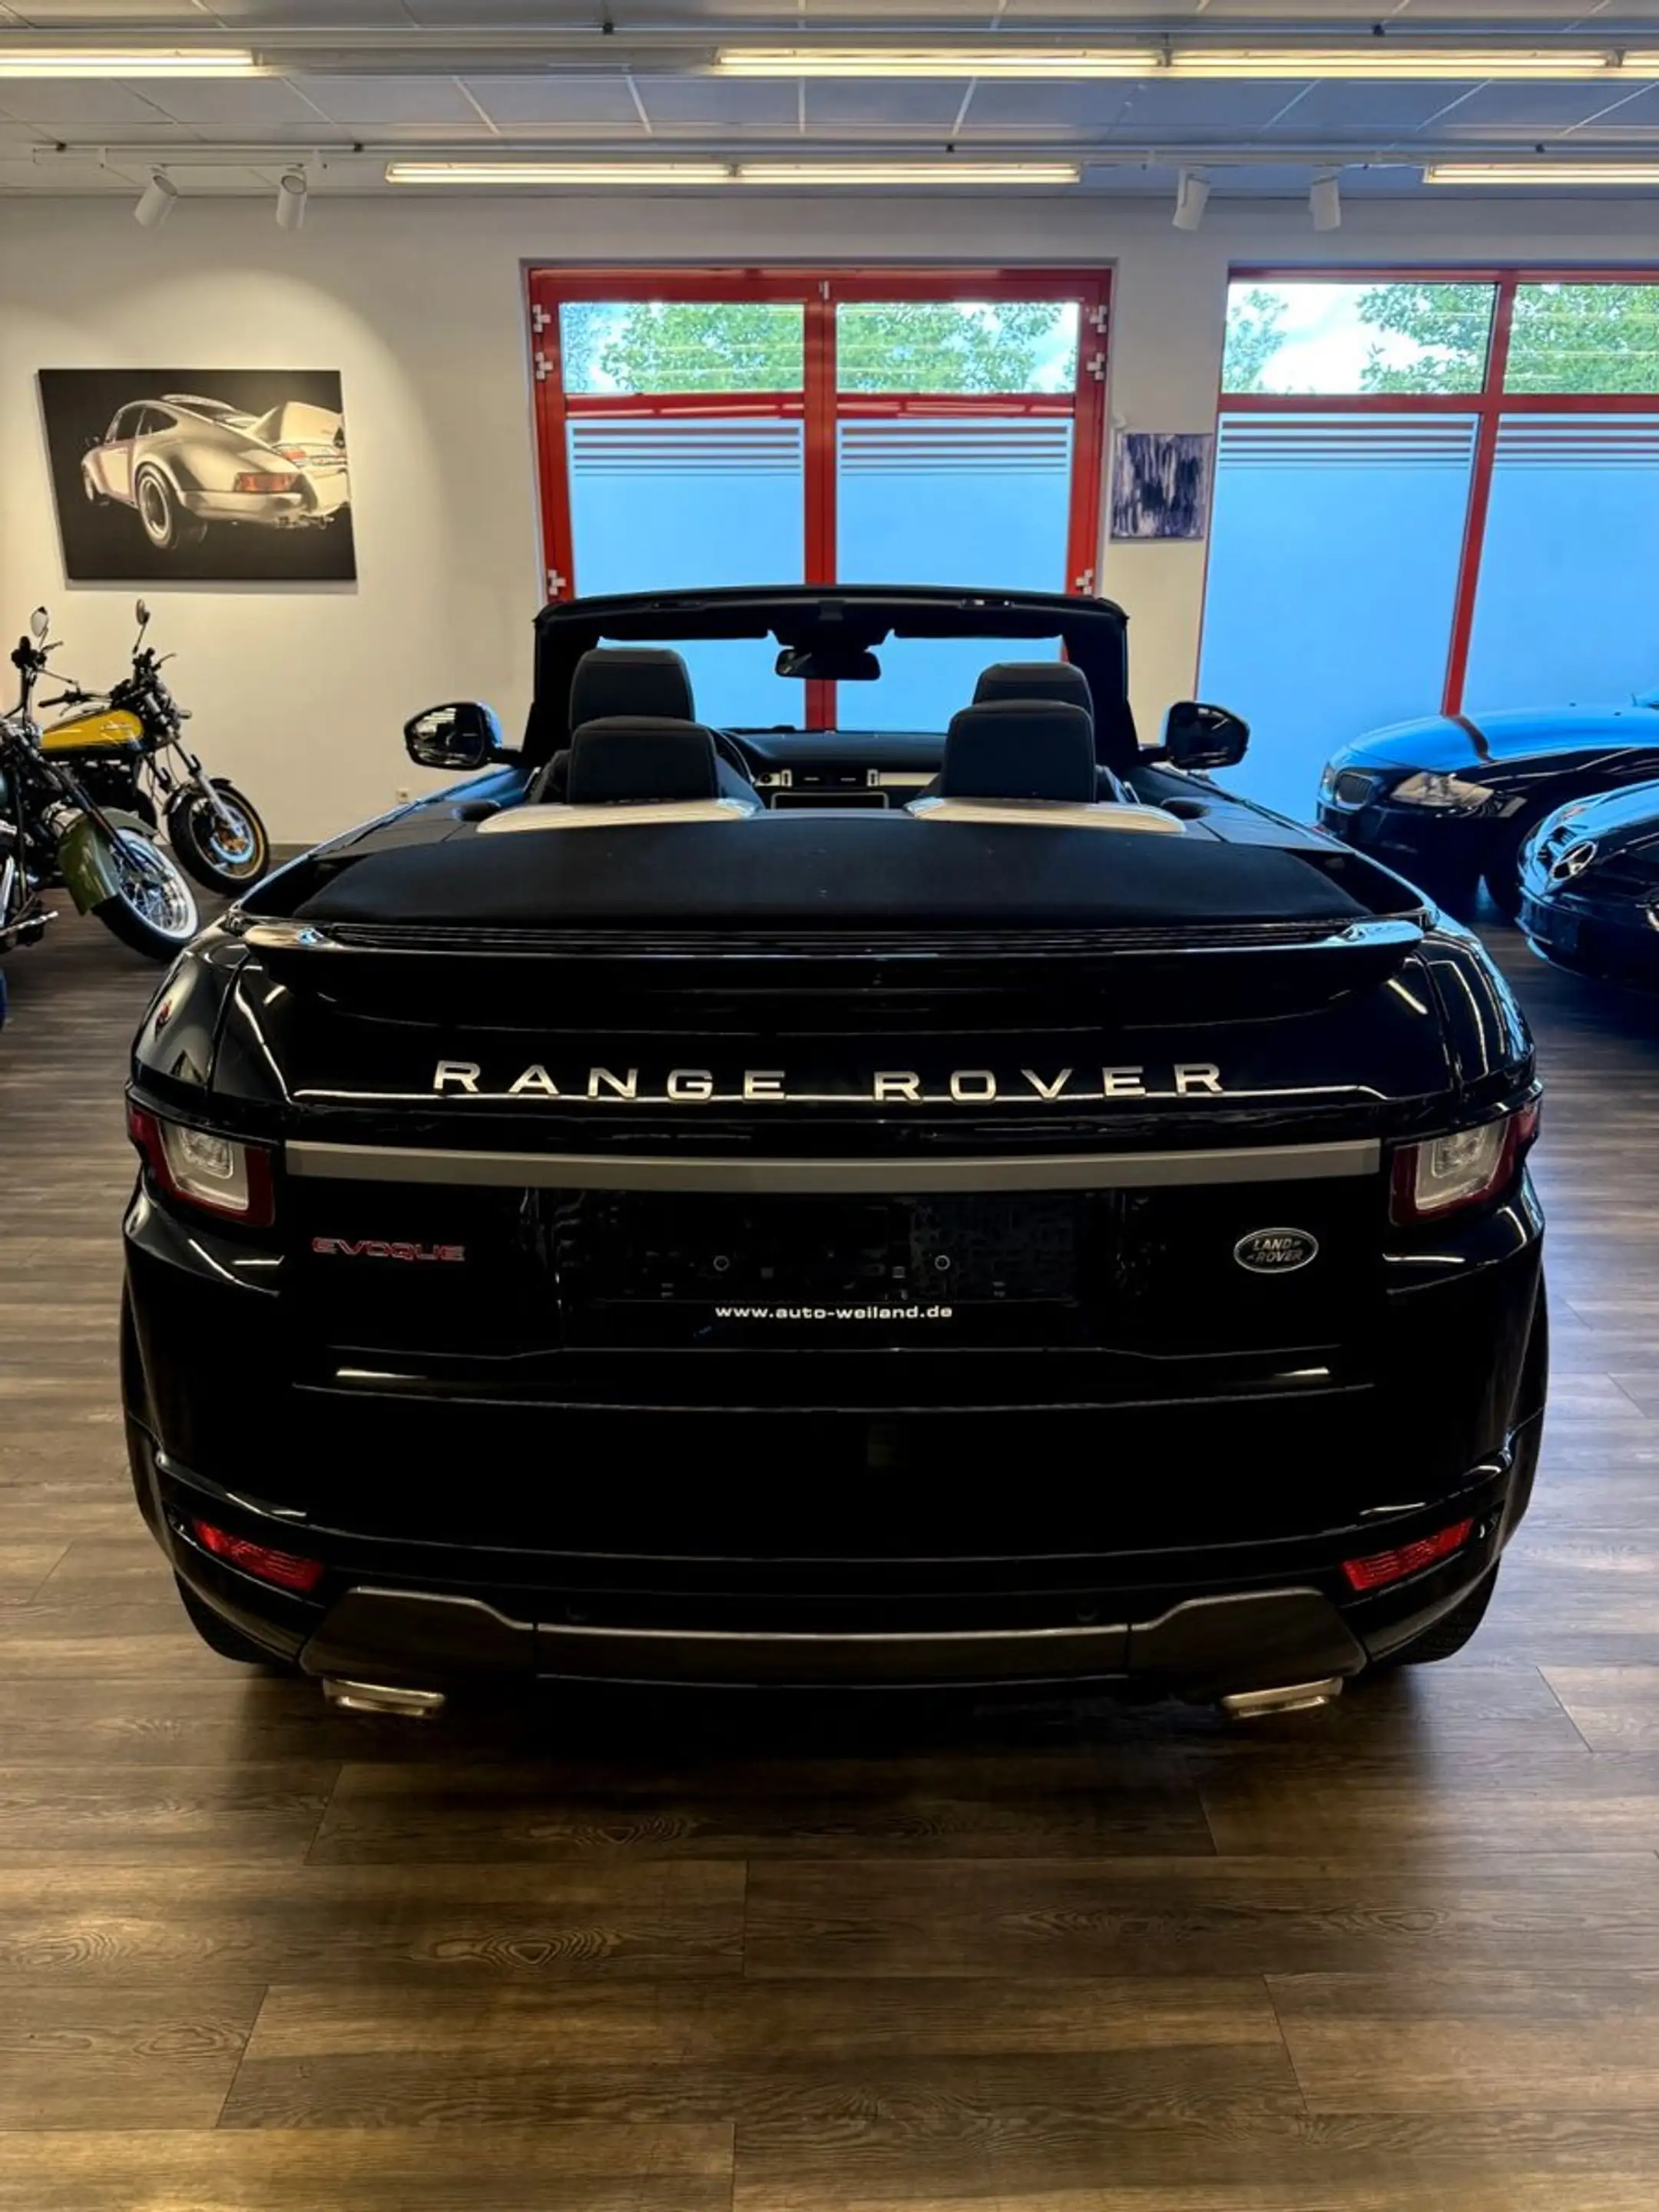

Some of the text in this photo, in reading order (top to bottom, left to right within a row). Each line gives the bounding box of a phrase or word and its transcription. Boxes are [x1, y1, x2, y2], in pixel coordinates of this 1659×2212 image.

[432, 1060, 1224, 1102] RANGE ROVER
[312, 1237, 465, 1261] EVOQUE
[1253, 1238, 1293, 1250] LAND
[1255, 1249, 1303, 1263] ROVER
[714, 1305, 953, 1320] www.auto-weiland.de
